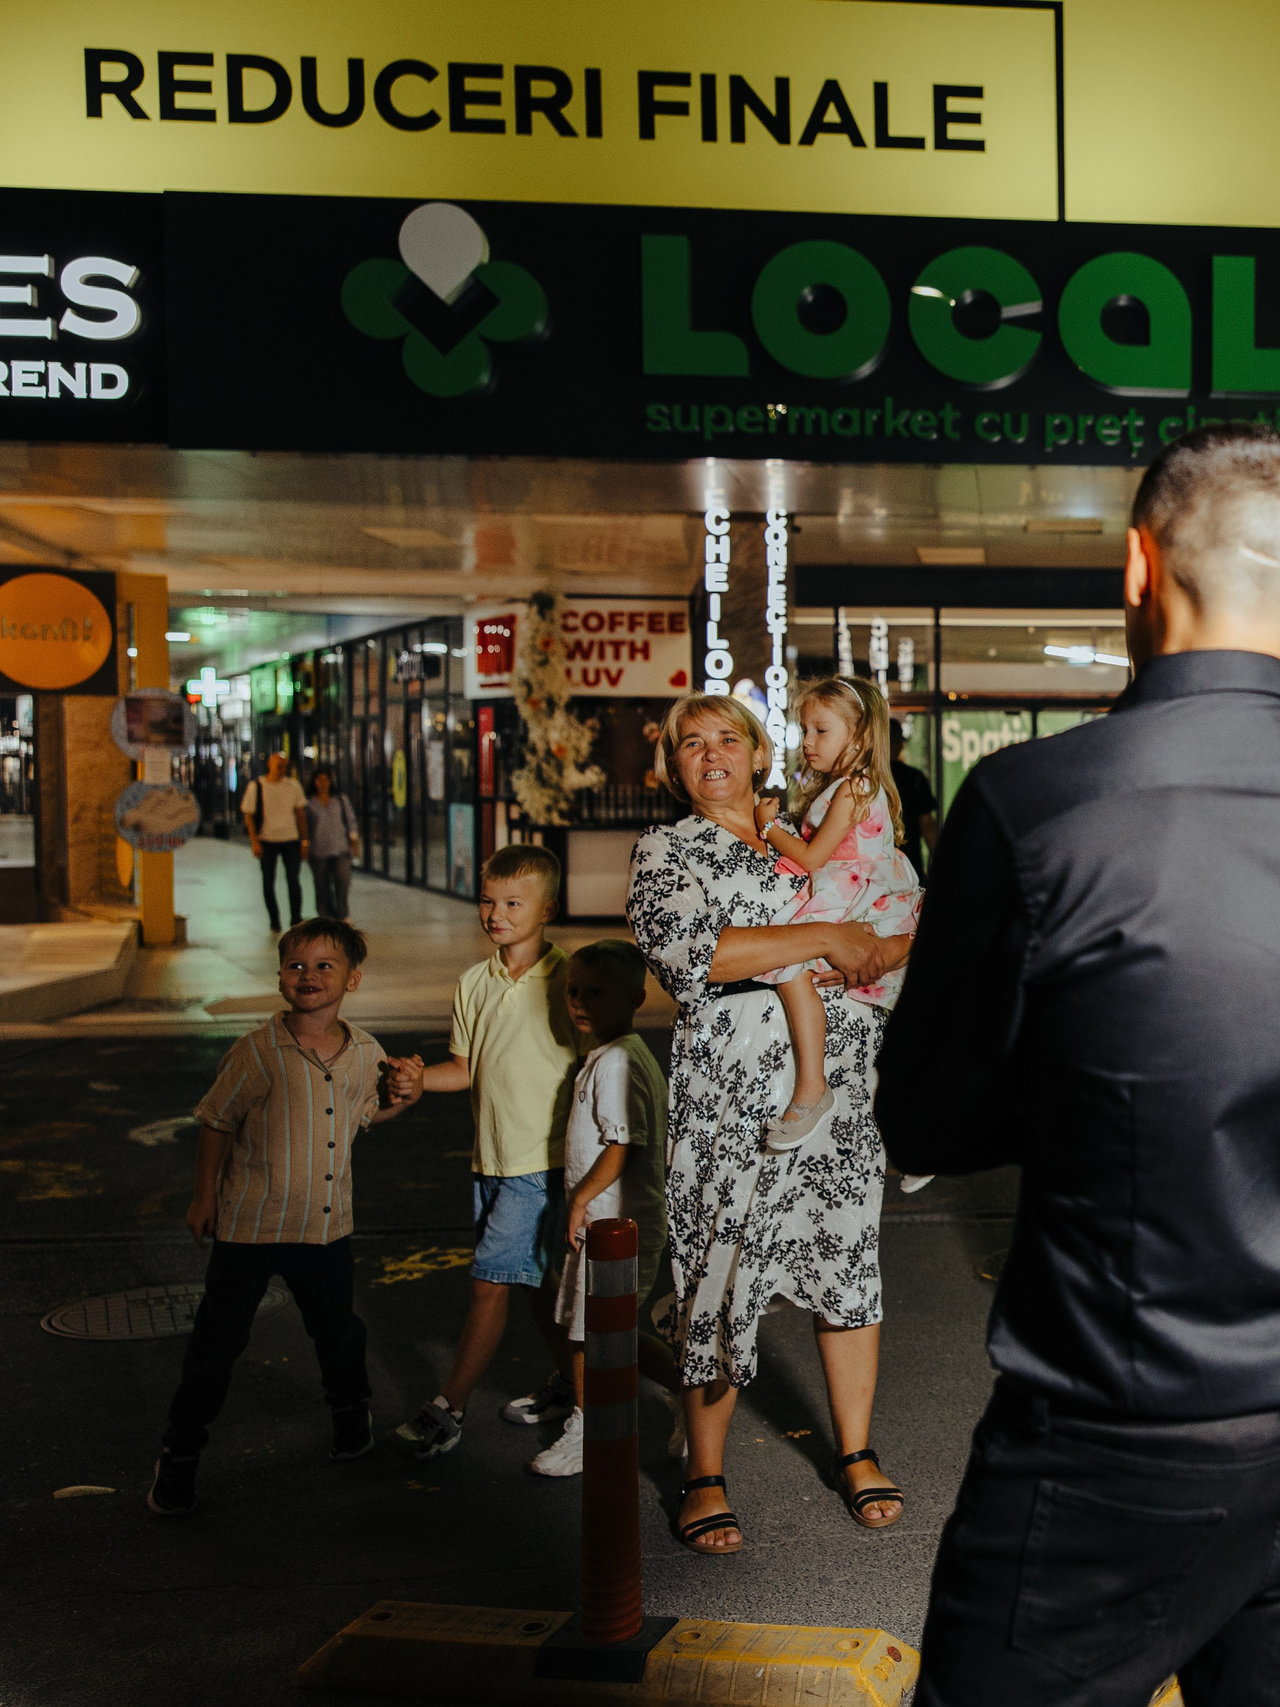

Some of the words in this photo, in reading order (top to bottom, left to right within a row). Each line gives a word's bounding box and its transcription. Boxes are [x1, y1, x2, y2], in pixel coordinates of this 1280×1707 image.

[83, 48, 602, 138] REDUCERI
[637, 69, 988, 152] FINALE
[645, 395, 961, 441] supermarket
[974, 408, 1028, 443] cu
[561, 610, 686, 634] COFFEE
[563, 639, 651, 661] WITH
